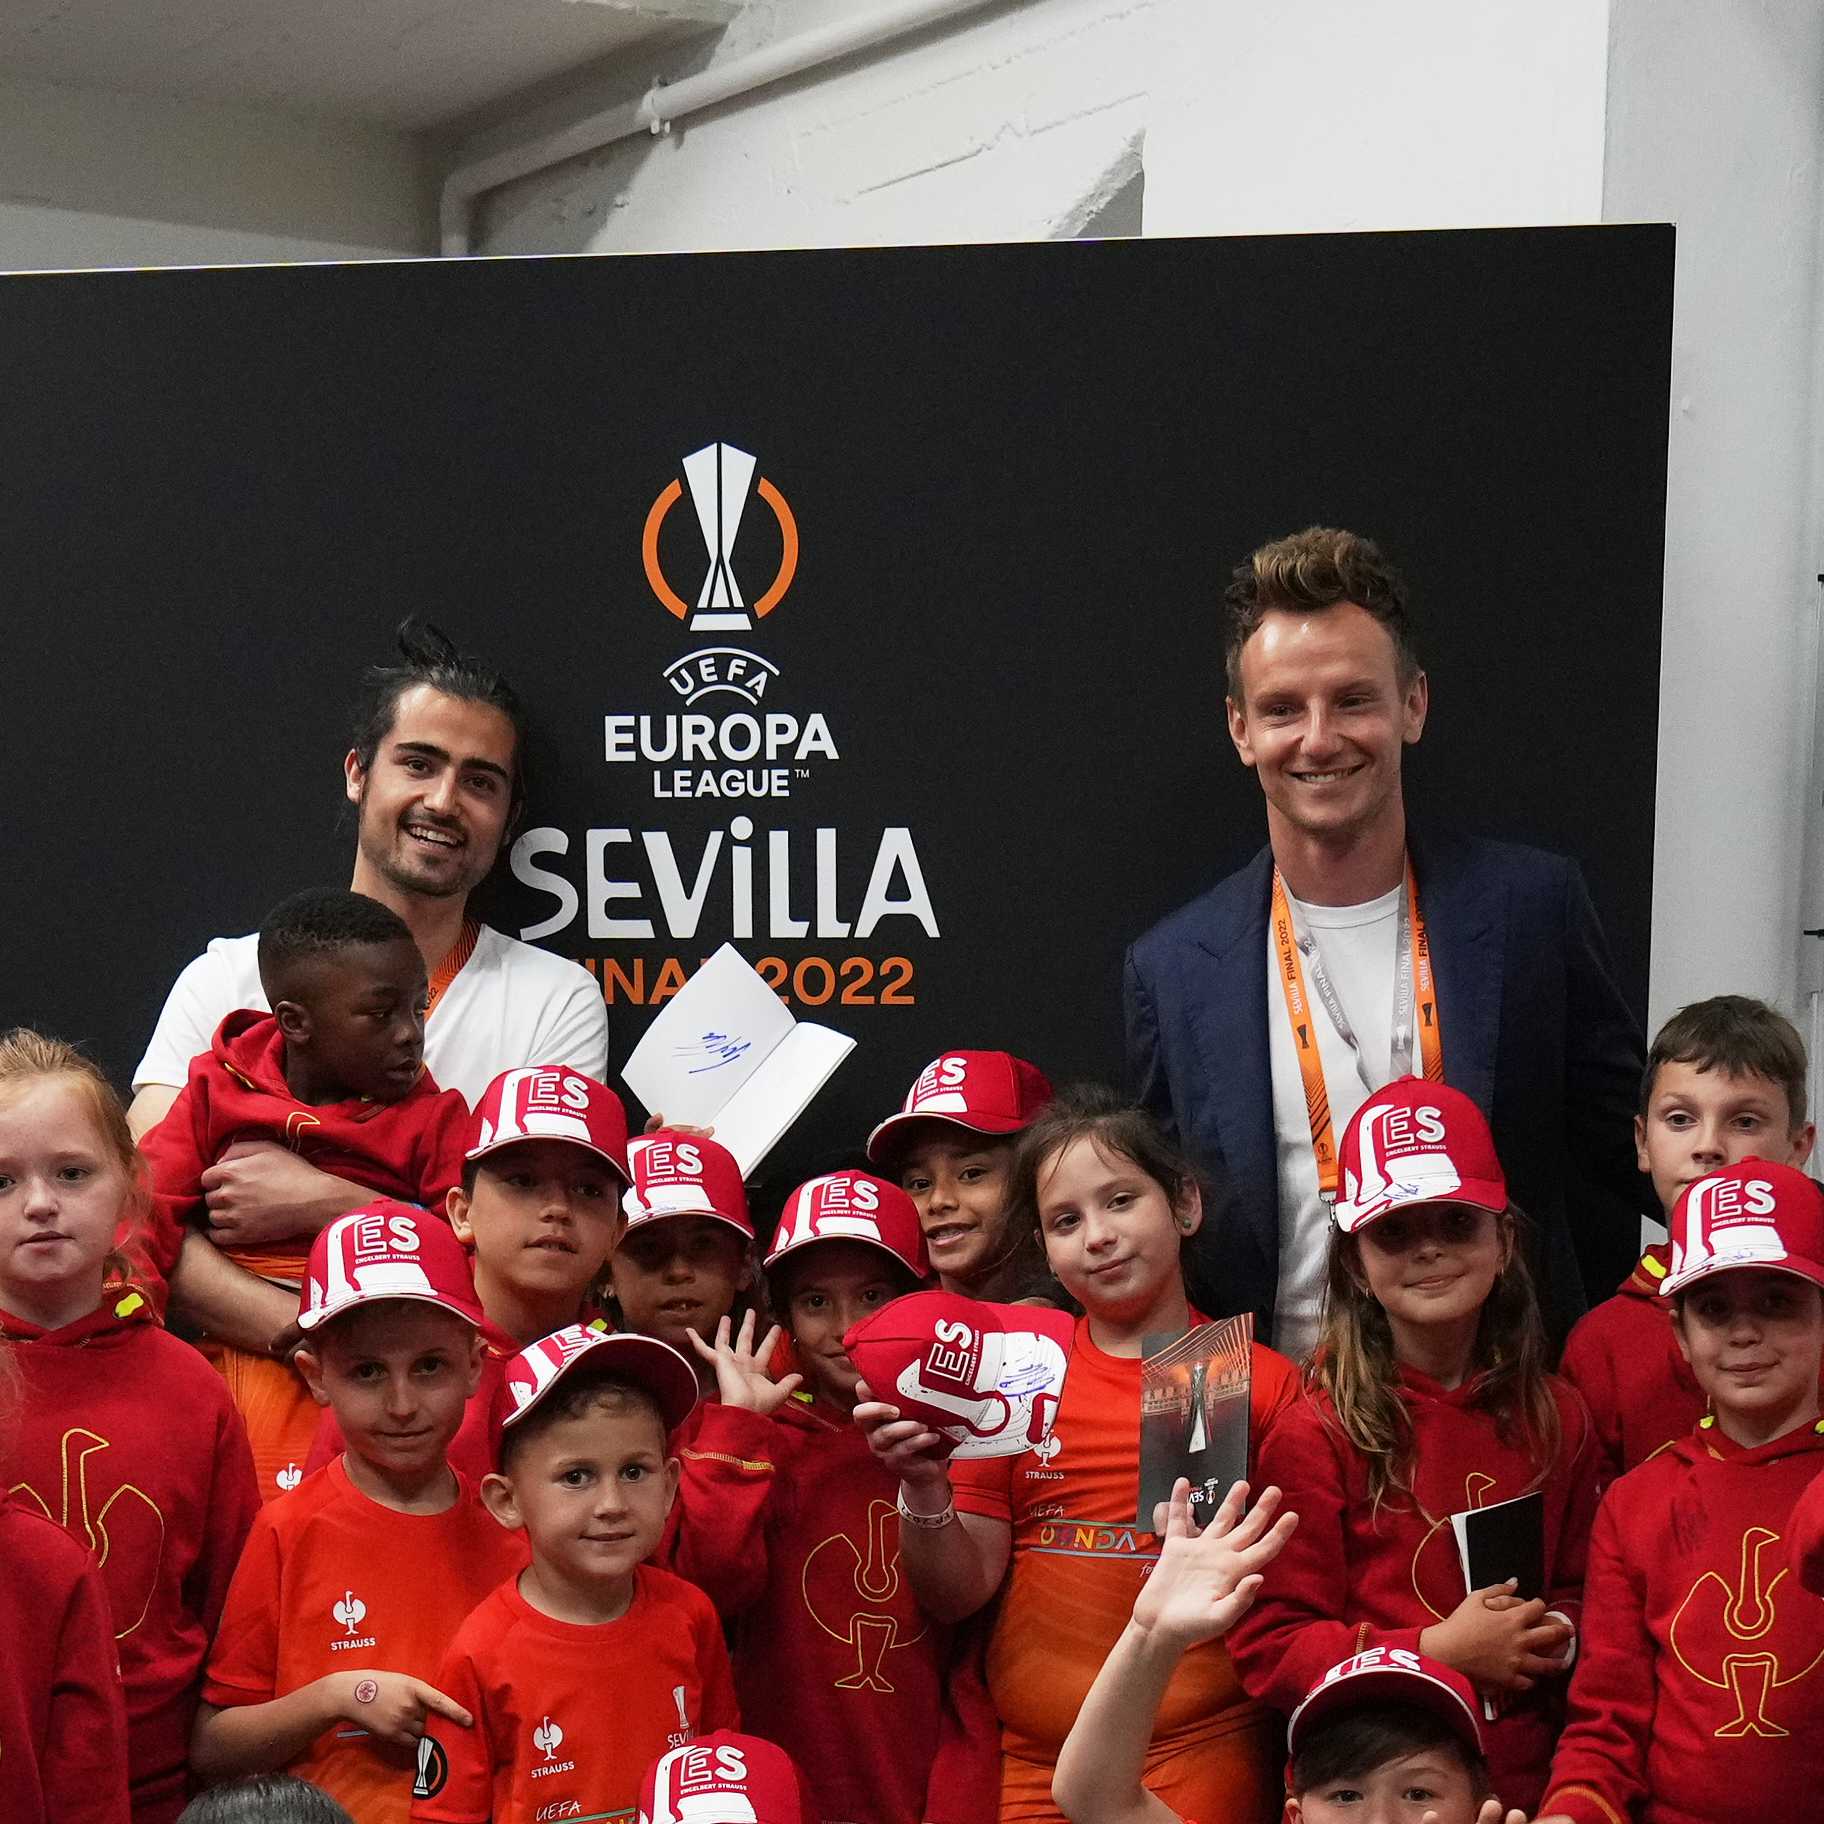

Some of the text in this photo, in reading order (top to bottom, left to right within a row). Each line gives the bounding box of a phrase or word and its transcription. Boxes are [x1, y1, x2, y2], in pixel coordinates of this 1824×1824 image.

[668, 656, 767, 697] UEFA
[603, 713, 840, 762] EUROPA
[1278, 919, 1290, 946] 2022
[570, 956, 915, 1006] INA 2022
[1284, 951, 1296, 981] FINAL
[1400, 948, 1412, 980] FINAL
[528, 1073, 590, 1109] ES
[916, 1057, 967, 1096] ES
[1383, 1106, 1445, 1149] ES
[646, 1142, 703, 1176] ES
[821, 1178, 879, 1211] ES
[1711, 1180, 1776, 1220] ES
[354, 1215, 421, 1256] ES
[355, 1252, 420, 1264] ENGELBERT STRAUSS
[926, 1319, 973, 1382] ES
[1025, 1471, 1065, 1480] STRAUSS
[331, 1637, 376, 1651] STRAUSS
[531, 1761, 575, 1779] STRAUSS
[681, 1746, 747, 1786] ES
[680, 1783, 716, 1795] ENGELBERT
[536, 1800, 582, 1822] UEFA
